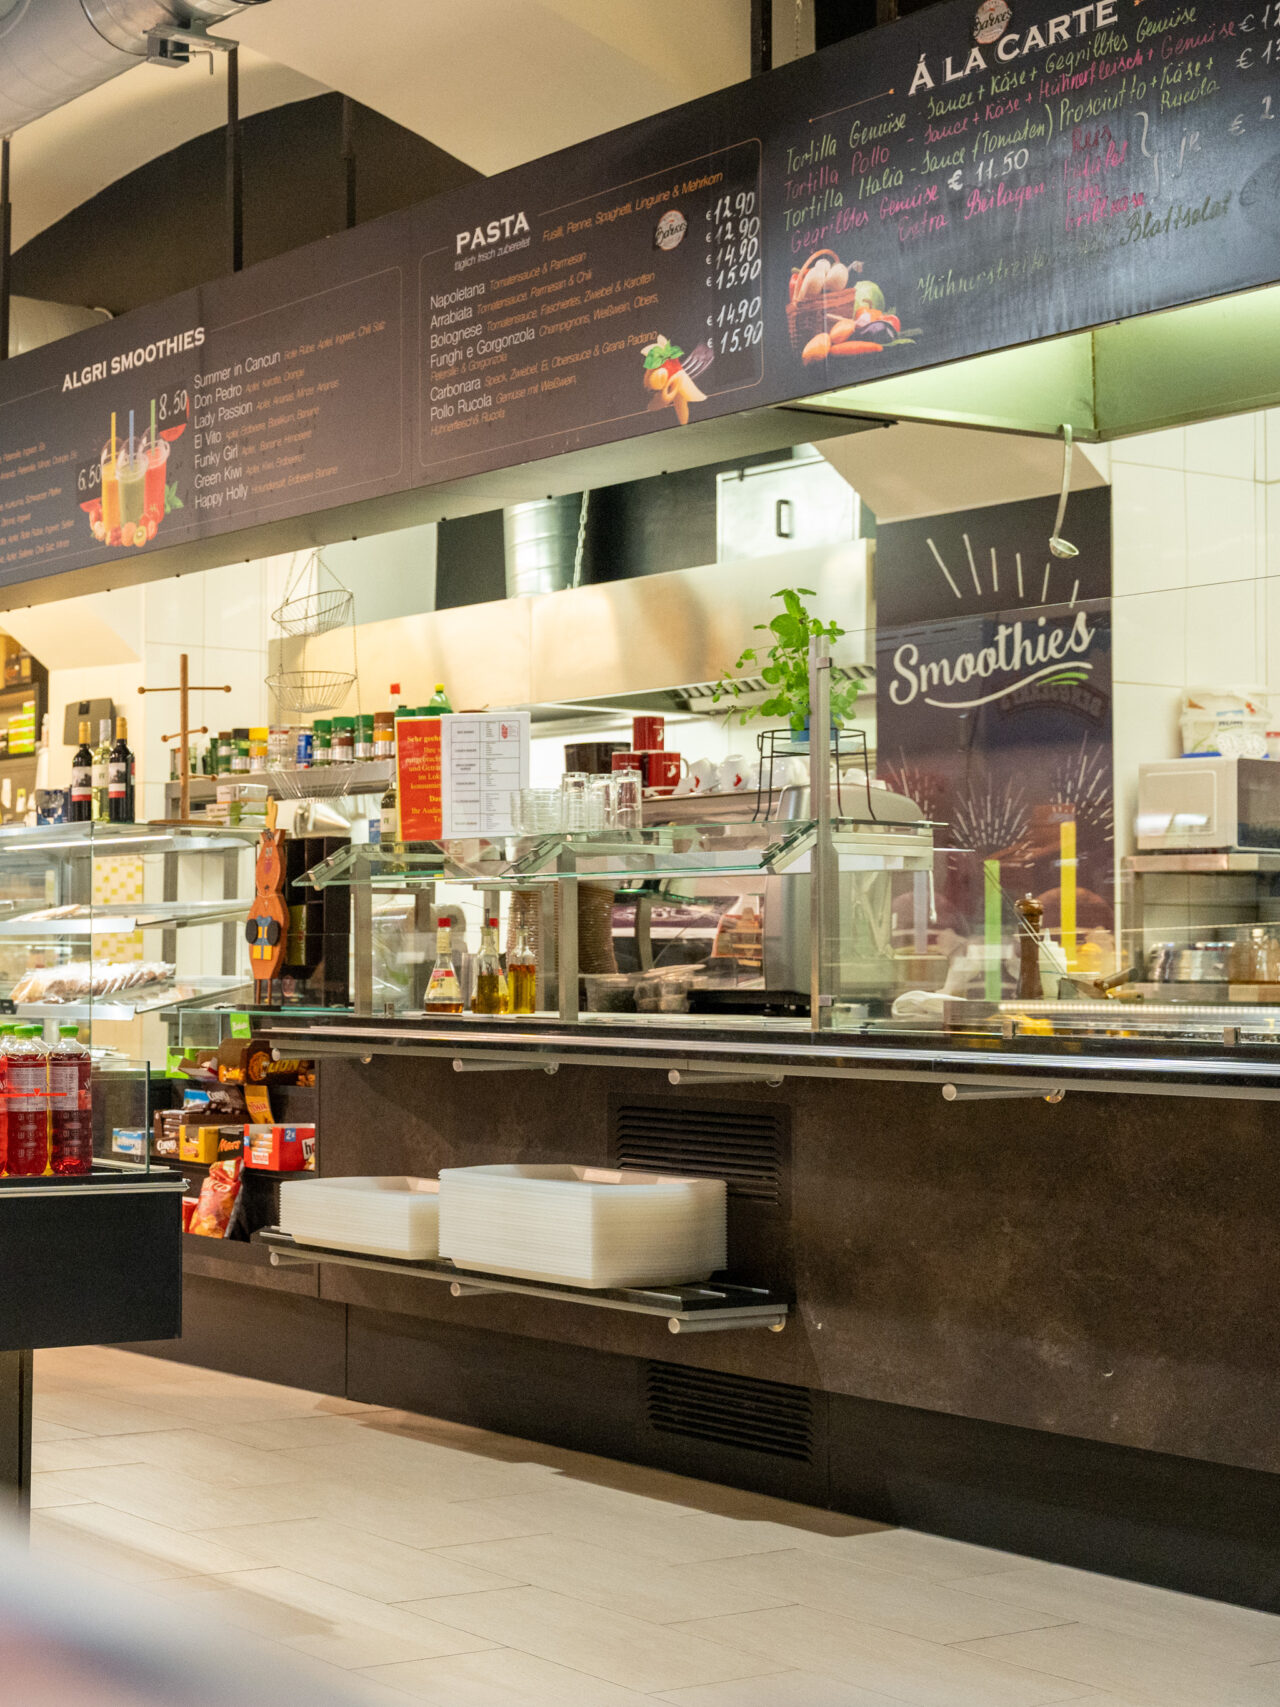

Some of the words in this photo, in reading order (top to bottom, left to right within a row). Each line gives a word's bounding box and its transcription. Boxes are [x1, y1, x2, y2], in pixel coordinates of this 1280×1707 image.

[943, 47, 987, 84] LA
[996, 0, 1118, 63] CARTE
[786, 134, 837, 174] Tortilla
[991, 70, 1026, 96] Käse
[784, 189, 843, 231] Tortilla
[859, 167, 903, 200] Italia
[1160, 62, 1201, 90] Käse
[784, 166, 839, 200] Tortilla
[851, 148, 890, 176] Pollo
[985, 98, 1020, 121] Käse
[714, 191, 755, 225] 12.90
[456, 211, 531, 255] PASTA
[716, 237, 758, 270] 14.90
[716, 258, 762, 290] 15.90
[430, 282, 485, 310] Napoletana
[716, 296, 762, 328] 14.90
[430, 306, 473, 329] Arrabiata
[430, 323, 483, 350] Bolognese
[430, 350, 463, 369] Funghi
[466, 347, 474, 358] e
[476, 326, 536, 355] Gorgonzola
[720, 321, 764, 354] 15.90
[61, 360, 107, 393] ALGRI
[111, 327, 205, 375] SMOOTHIES
[194, 366, 231, 389] Summer
[234, 363, 242, 376] in
[245, 352, 280, 373] Cancun
[195, 394, 212, 409] Don
[216, 384, 242, 402] Pedro
[430, 378, 481, 402] Carbonara
[195, 411, 215, 429] Lady
[218, 402, 253, 421] Passion
[430, 405, 455, 422] Pollo
[457, 394, 492, 414] Rucola
[195, 434, 202, 449] El
[206, 431, 221, 445] Vito
[195, 451, 220, 469] Funky
[223, 444, 238, 460] Girl
[195, 472, 221, 489] Green
[224, 464, 242, 480] Kiwi
[195, 491, 224, 509] Happy
[226, 484, 248, 501] Holly
[889, 611, 1096, 705] Smoothies
